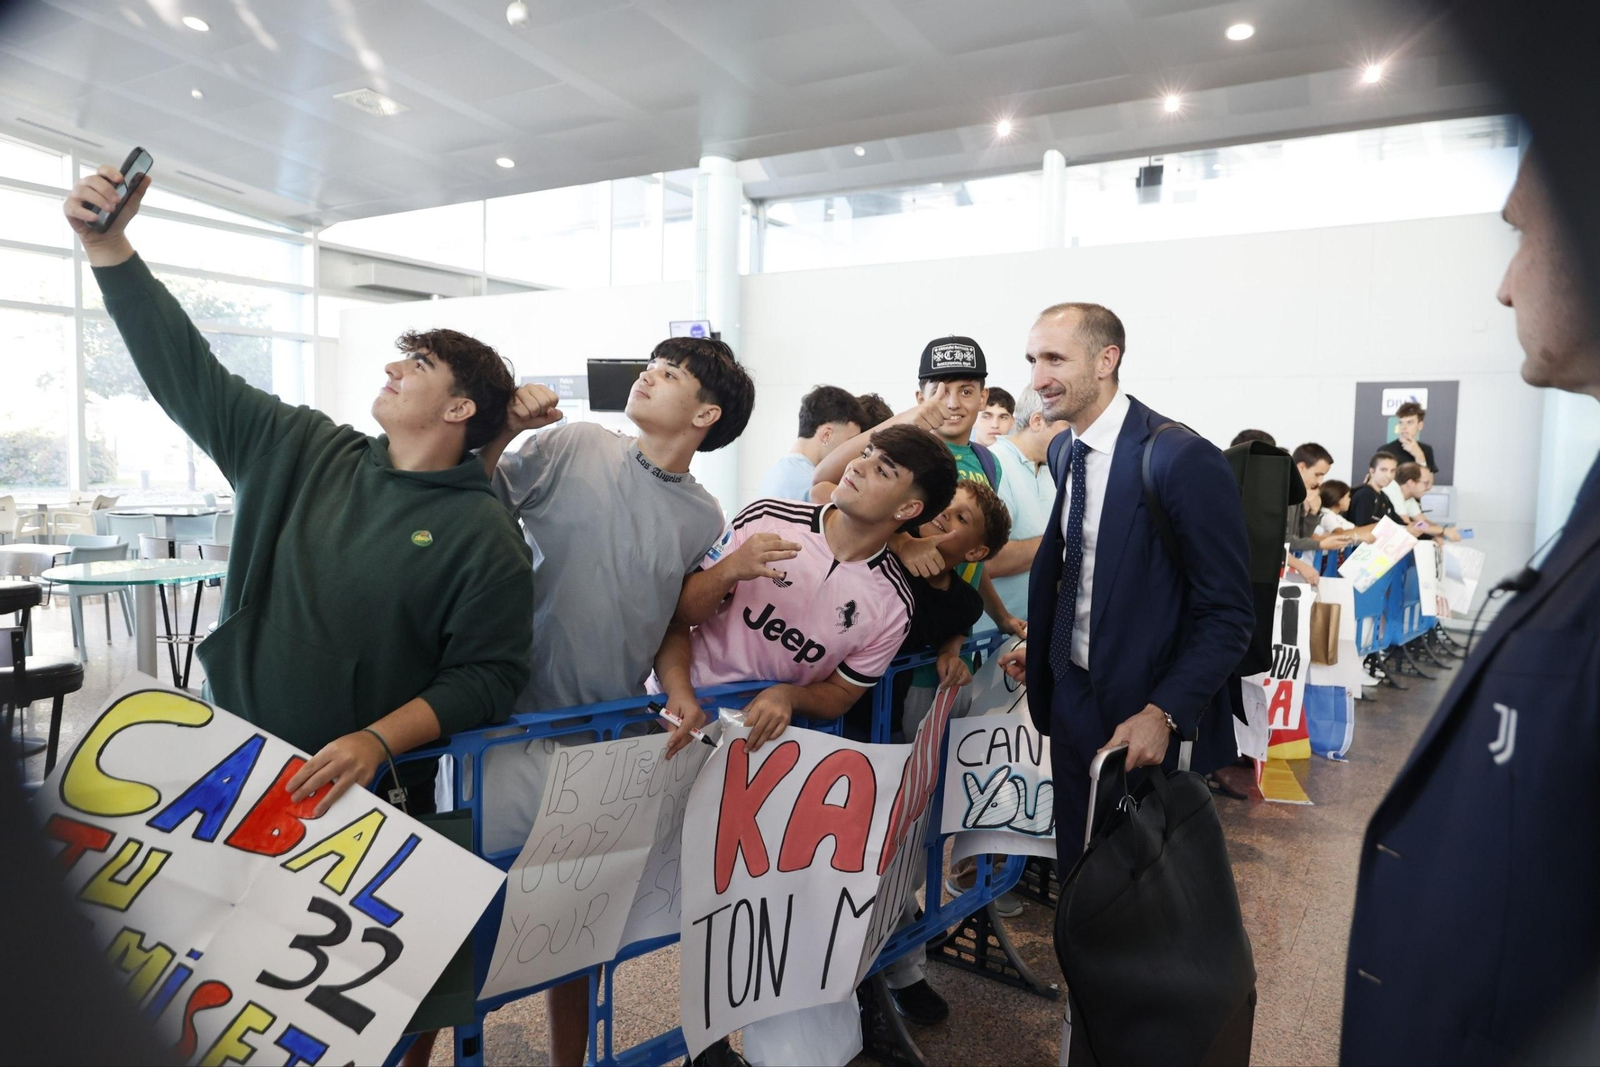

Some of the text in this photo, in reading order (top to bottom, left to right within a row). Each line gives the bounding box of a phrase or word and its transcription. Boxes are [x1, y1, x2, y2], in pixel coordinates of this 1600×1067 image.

[635, 450, 682, 483] Los Angeles
[743, 603, 826, 664] Jeep
[956, 724, 1043, 767] CAN
[60, 688, 422, 928] CABAL
[256, 896, 405, 1035] 32
[492, 893, 610, 983] YOUR
[692, 890, 794, 1029] TON
